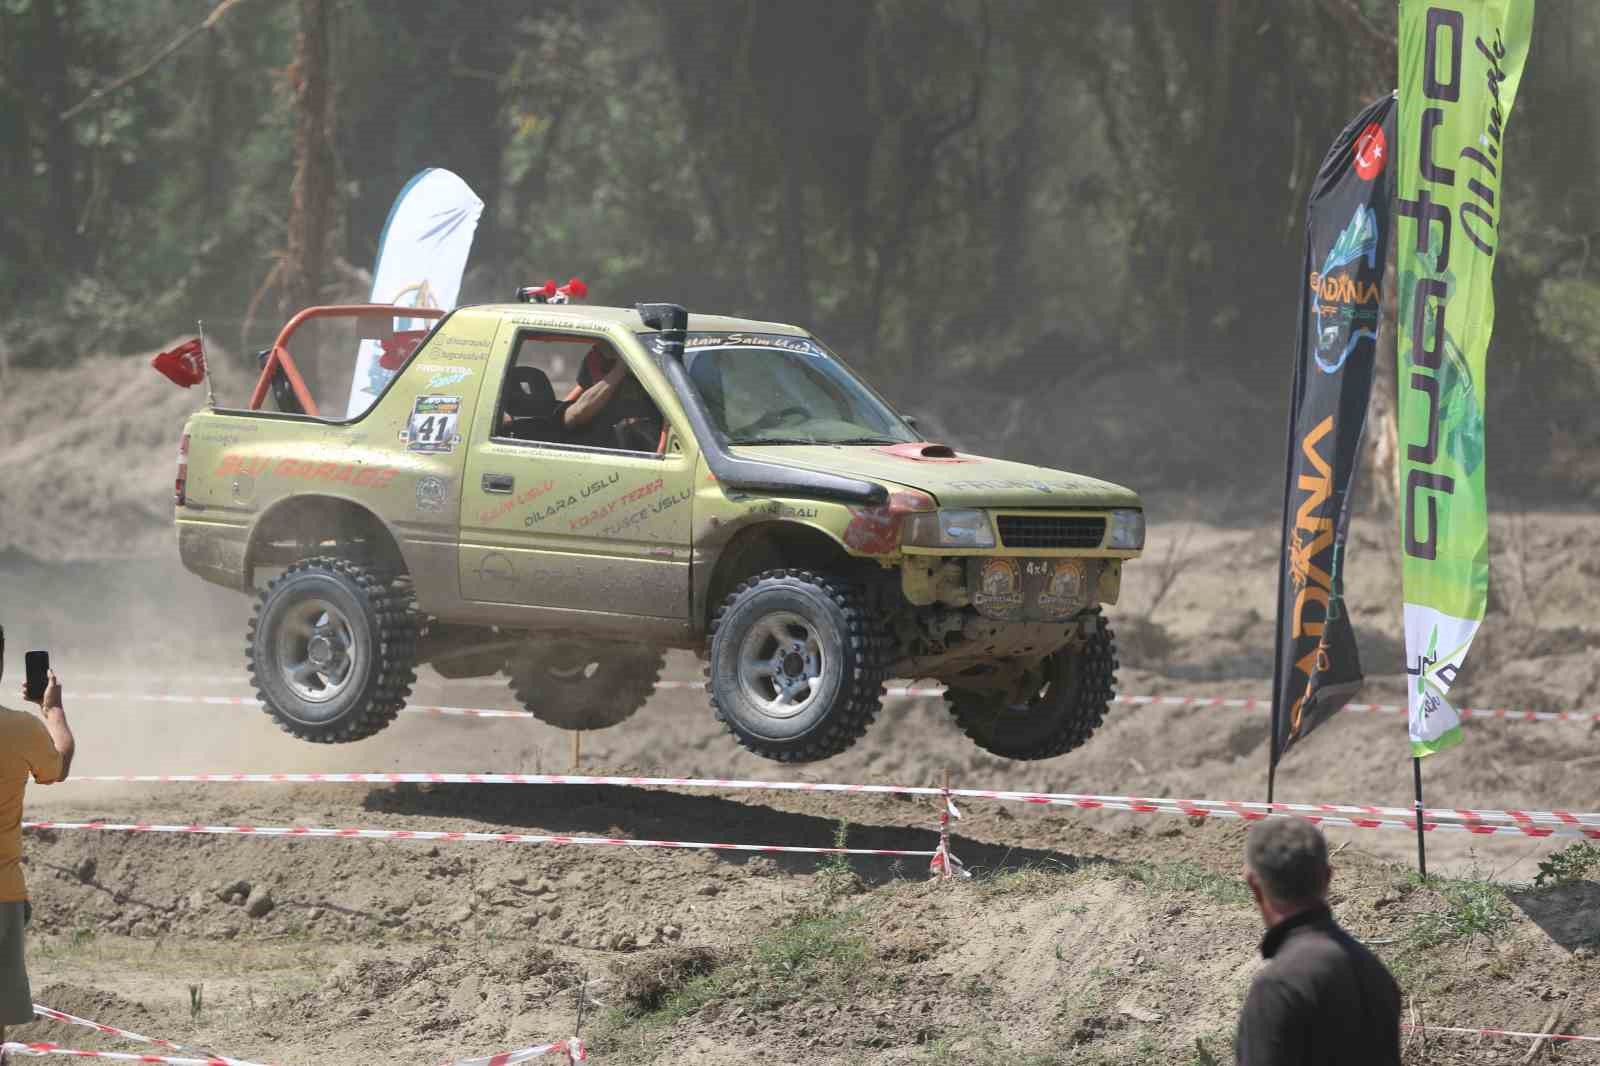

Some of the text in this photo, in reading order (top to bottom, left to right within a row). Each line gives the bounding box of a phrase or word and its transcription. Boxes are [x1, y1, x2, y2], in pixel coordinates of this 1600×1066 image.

[419, 415, 449, 441] 41
[580, 471, 620, 498] USLU
[616, 478, 664, 506] TEZER
[1026, 561, 1048, 575] 4x4
